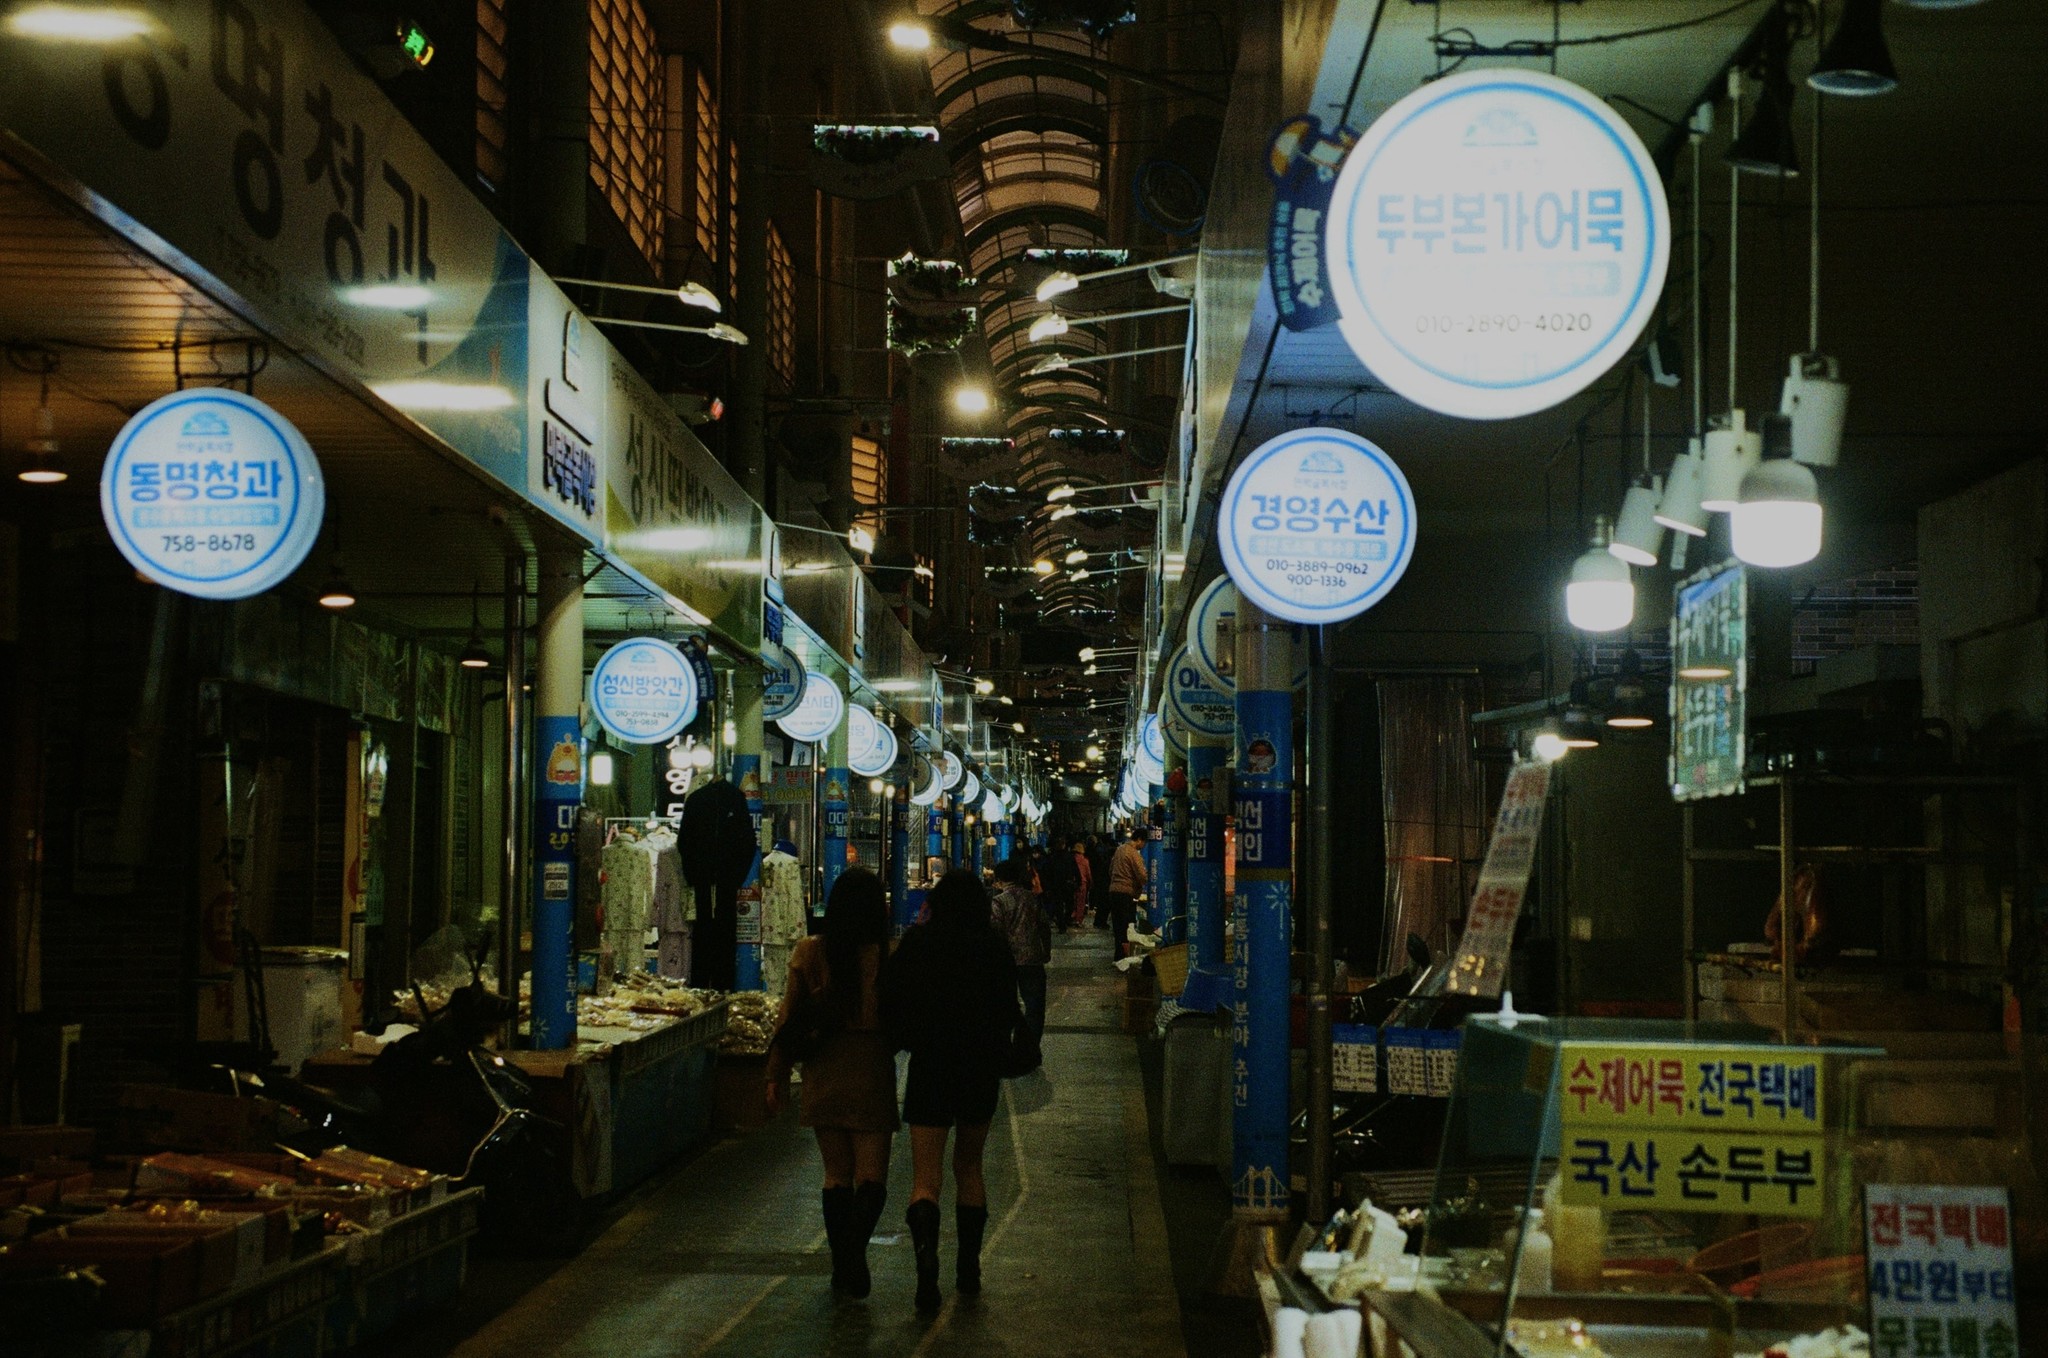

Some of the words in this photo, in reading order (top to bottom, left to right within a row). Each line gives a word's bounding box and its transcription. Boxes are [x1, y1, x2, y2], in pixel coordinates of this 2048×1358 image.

[129, 459, 282, 502] 동명청과
[1251, 494, 1391, 536] 경영수산
[161, 533, 256, 552] 758-8678
[1266, 558, 1369, 575] 010-3889-0962
[1287, 573, 1348, 588] 900-1336
[602, 673, 684, 699] 성신방앗간
[1234, 893, 1251, 991] 전통시장
[1234, 1000, 1251, 1049] 분야
[1571, 1139, 1660, 1197] 국산
[1678, 1143, 1816, 1204] 손두부
[1872, 1203, 2009, 1250] 전국택배
[1869, 1259, 2016, 1303] 4만원부터
